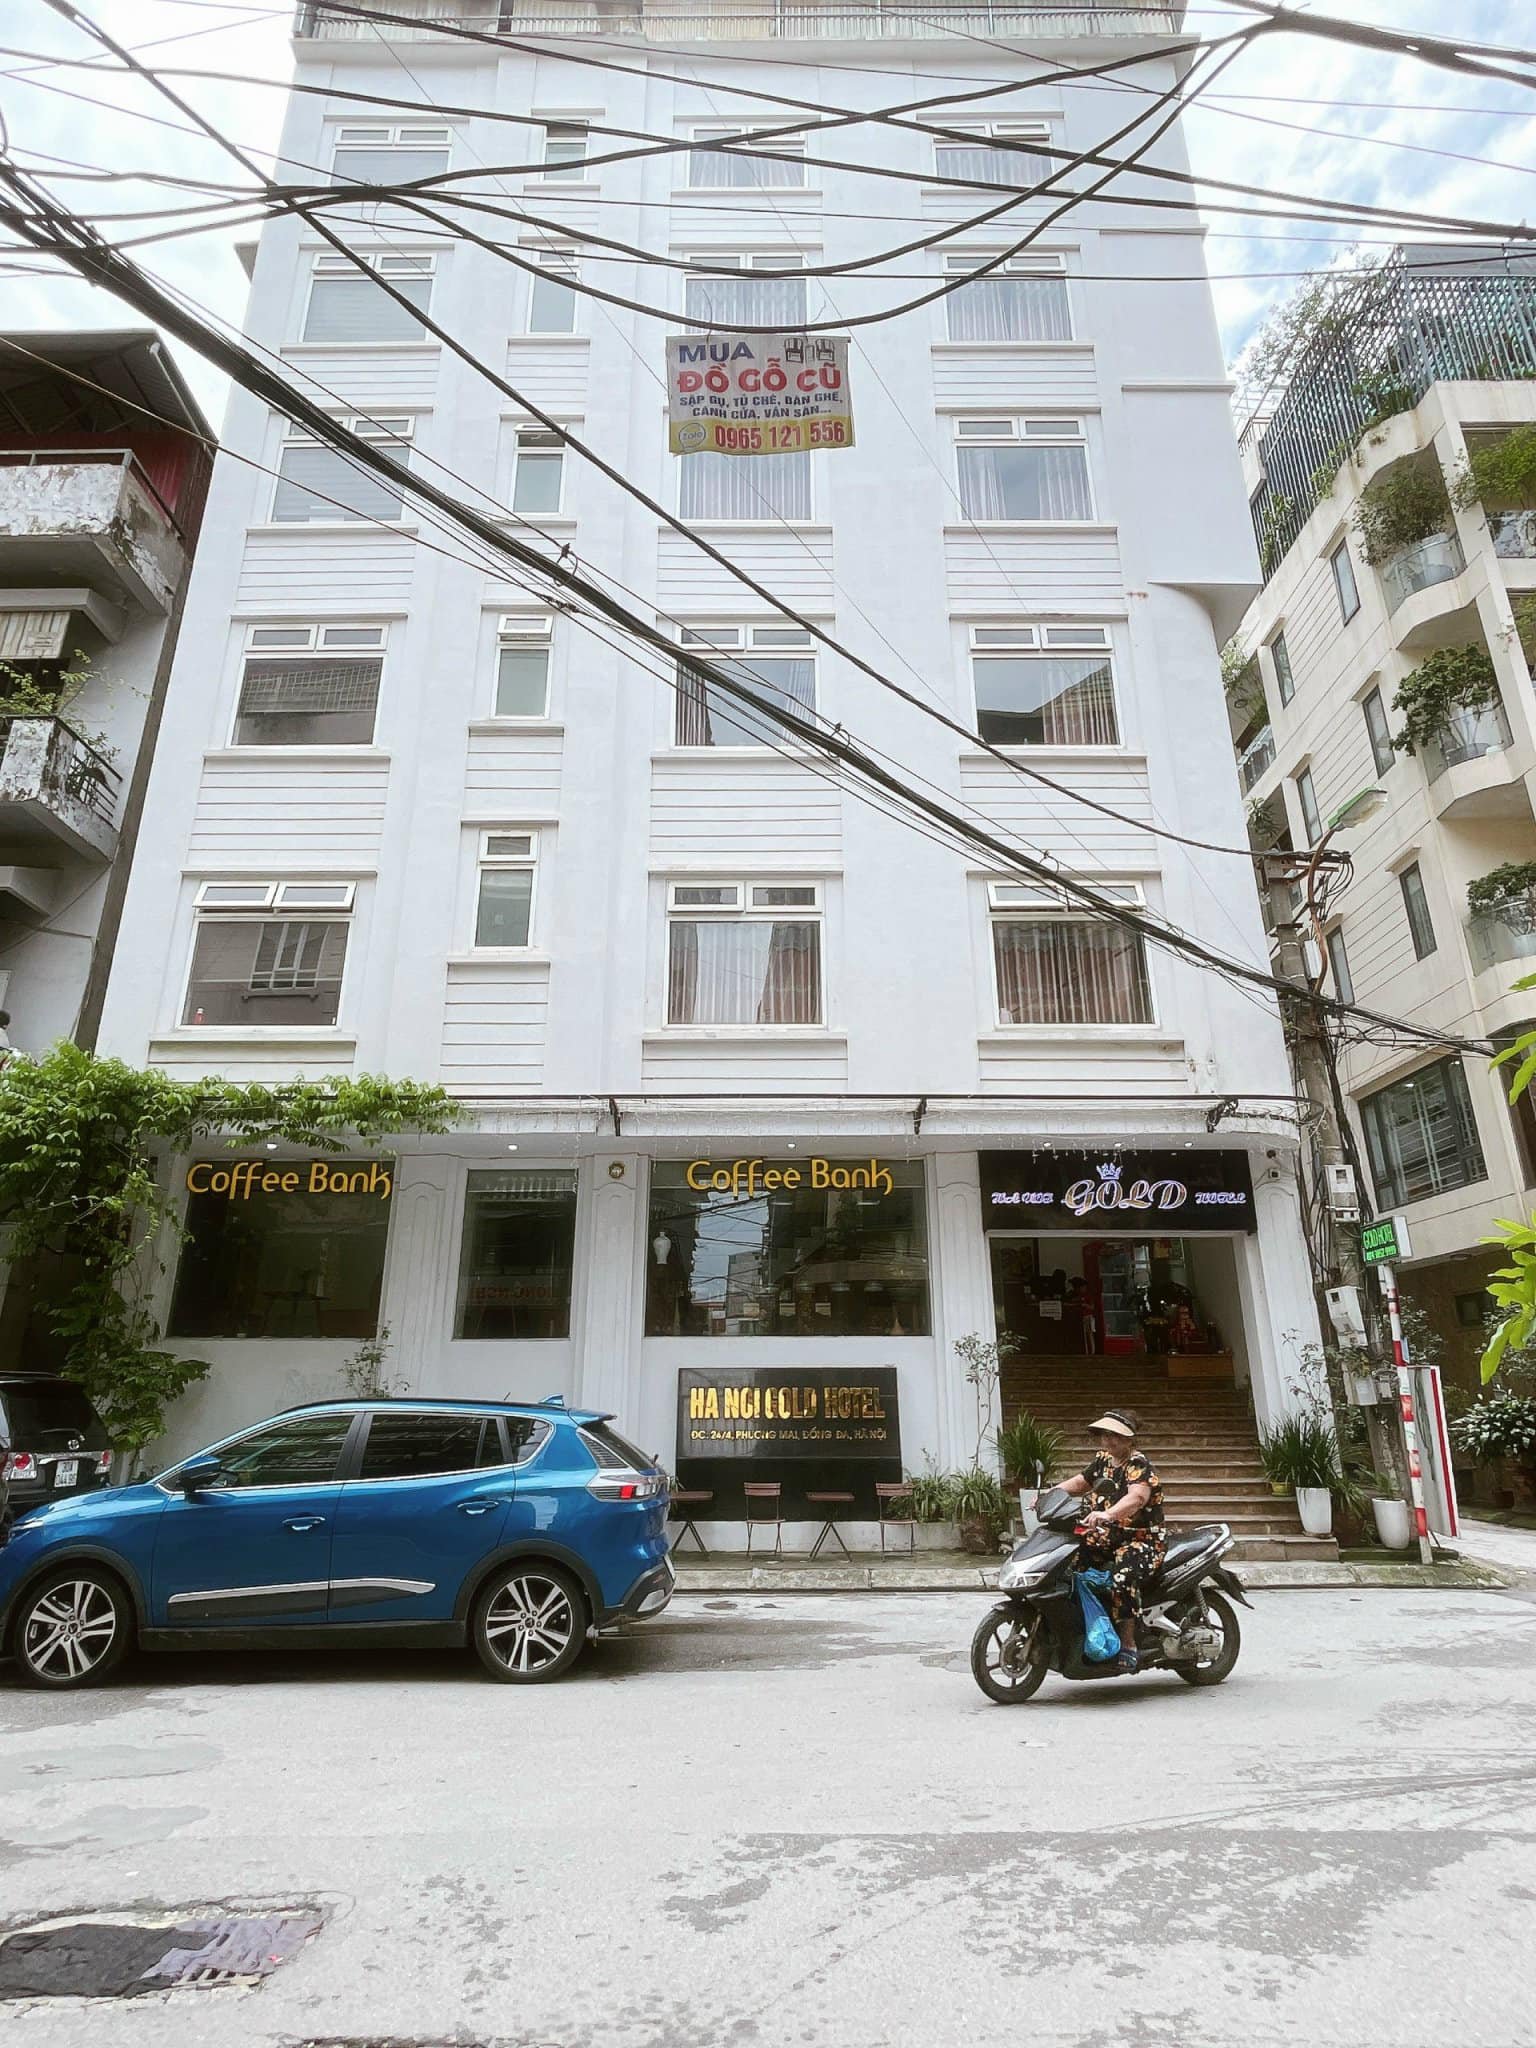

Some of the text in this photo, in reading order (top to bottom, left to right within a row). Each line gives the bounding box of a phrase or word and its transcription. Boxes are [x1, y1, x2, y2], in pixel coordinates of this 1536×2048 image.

[679, 341, 755, 363] MUA
[677, 357, 841, 393] ĐỒ GỖ CŨ
[715, 420, 845, 449] 0965 121 556
[186, 1162, 391, 1200] Coffee Bank
[687, 1158, 894, 1198] Coffee Bank
[1061, 1179, 1187, 1216] GOLD
[690, 1387, 719, 1419] HA
[765, 1387, 817, 1419] GOLD
[824, 1387, 885, 1418] HOTEL
